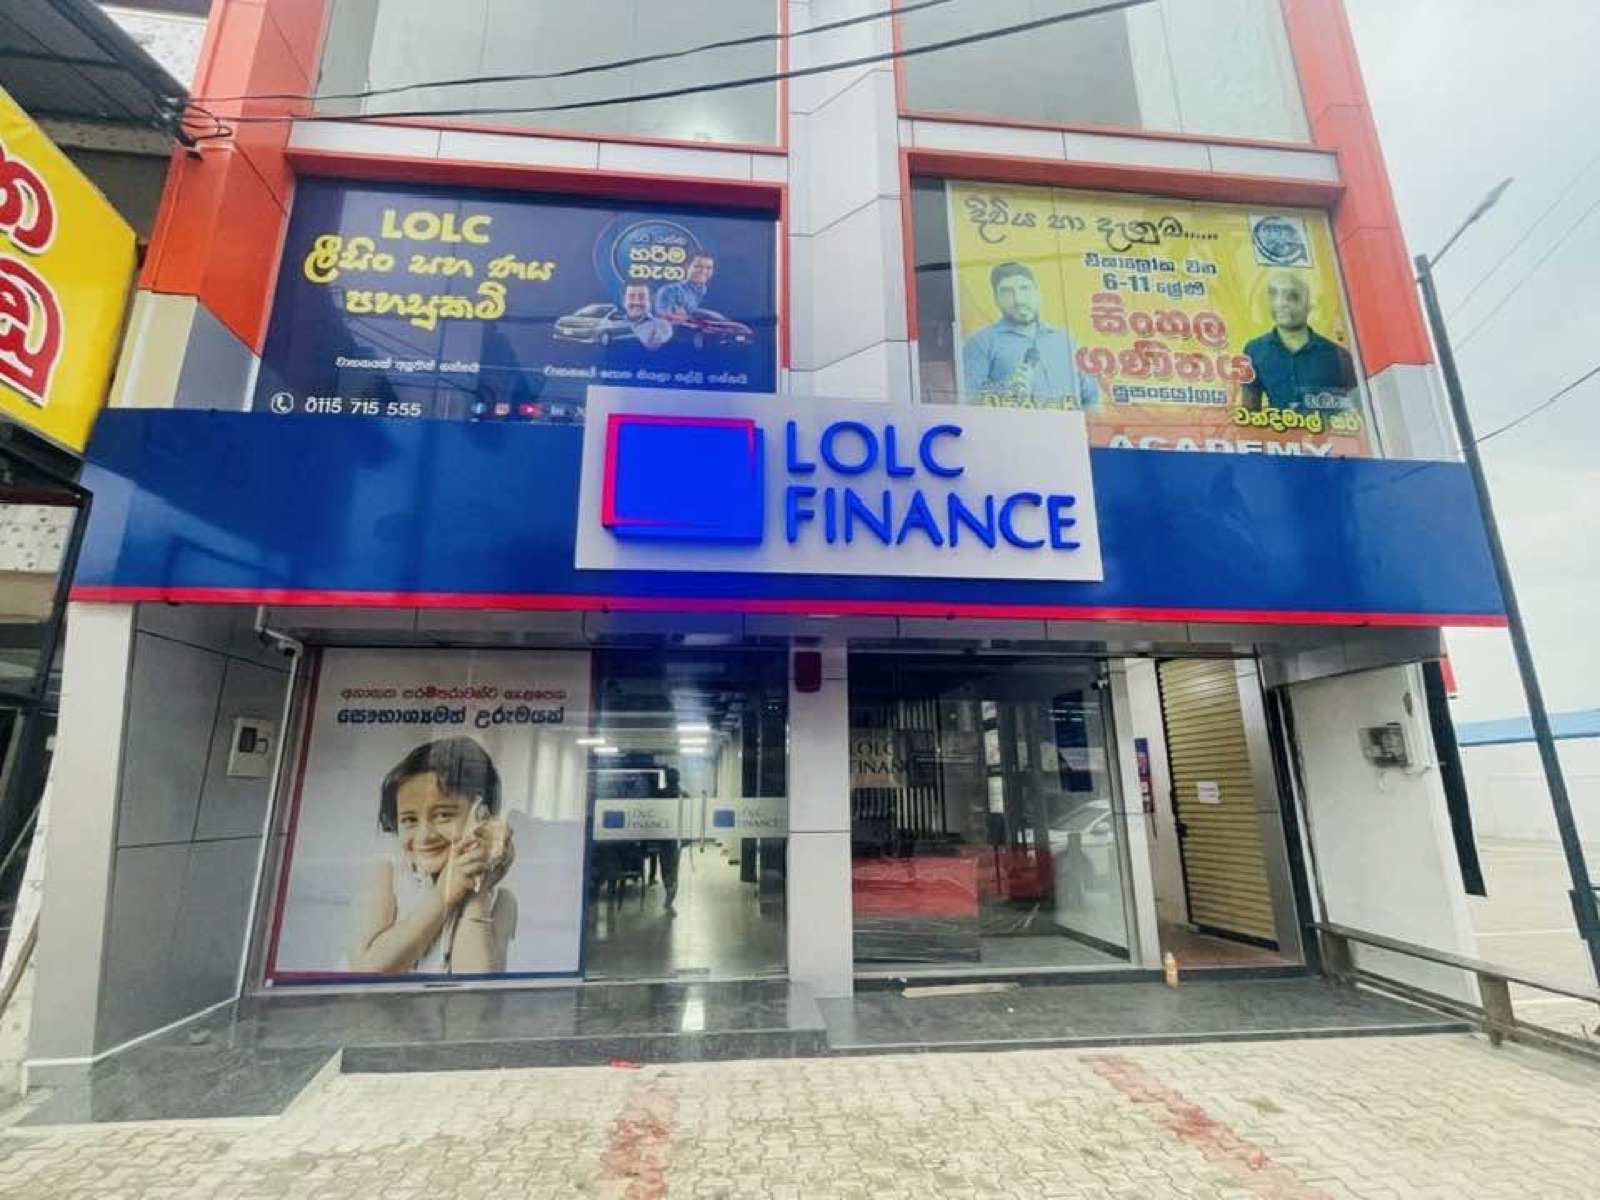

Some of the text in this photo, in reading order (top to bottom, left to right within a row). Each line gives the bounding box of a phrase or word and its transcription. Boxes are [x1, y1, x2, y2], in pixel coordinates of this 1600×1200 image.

[381, 208, 492, 243] LOLC
[408, 255, 473, 278] සහ
[1103, 272, 1150, 293] 6-11
[1091, 293, 1228, 349] සිංහල
[304, 397, 422, 416] 0115 715 555
[785, 420, 965, 478] LOLC
[785, 485, 1081, 551] FINANCE
